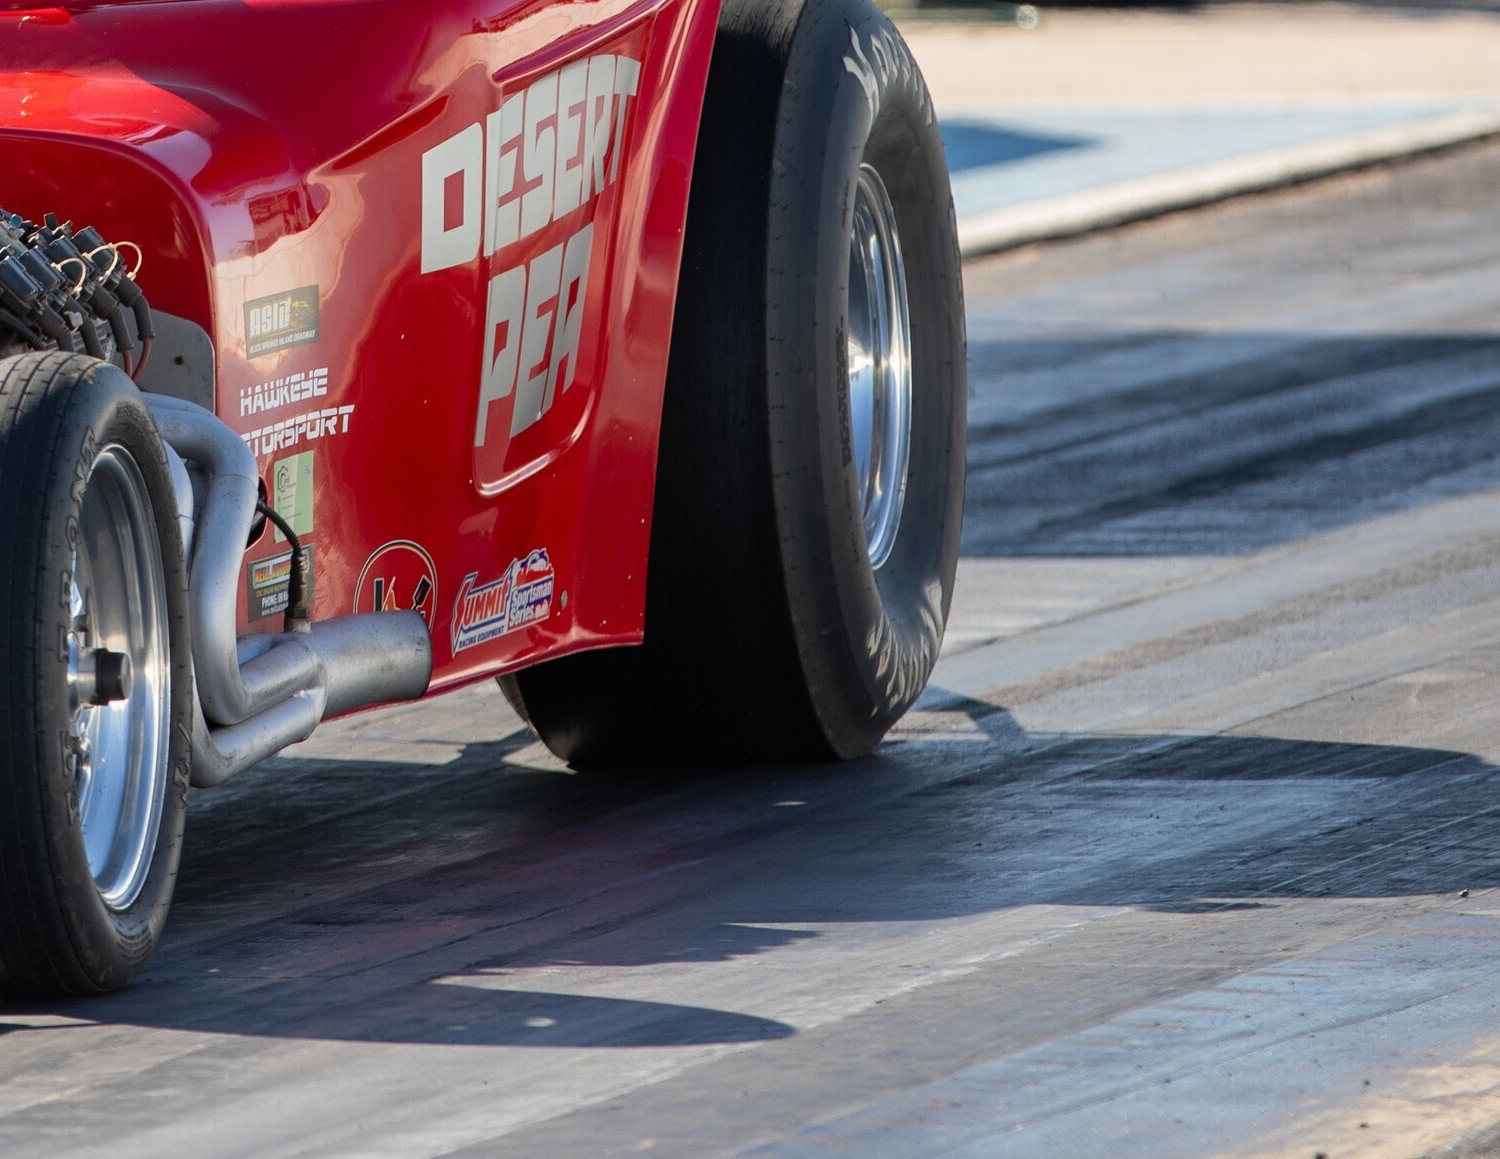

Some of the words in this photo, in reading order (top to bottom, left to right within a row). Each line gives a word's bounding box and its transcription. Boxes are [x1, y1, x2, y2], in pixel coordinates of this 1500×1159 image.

[420, 54, 642, 275] DESERT
[473, 221, 594, 448] PEA
[240, 367, 329, 417] HAWKEYE
[240, 404, 356, 458] TORSPORT
[453, 568, 511, 647] SUMMIT
[509, 603, 534, 627] Series
[511, 580, 552, 609] Sportsman
